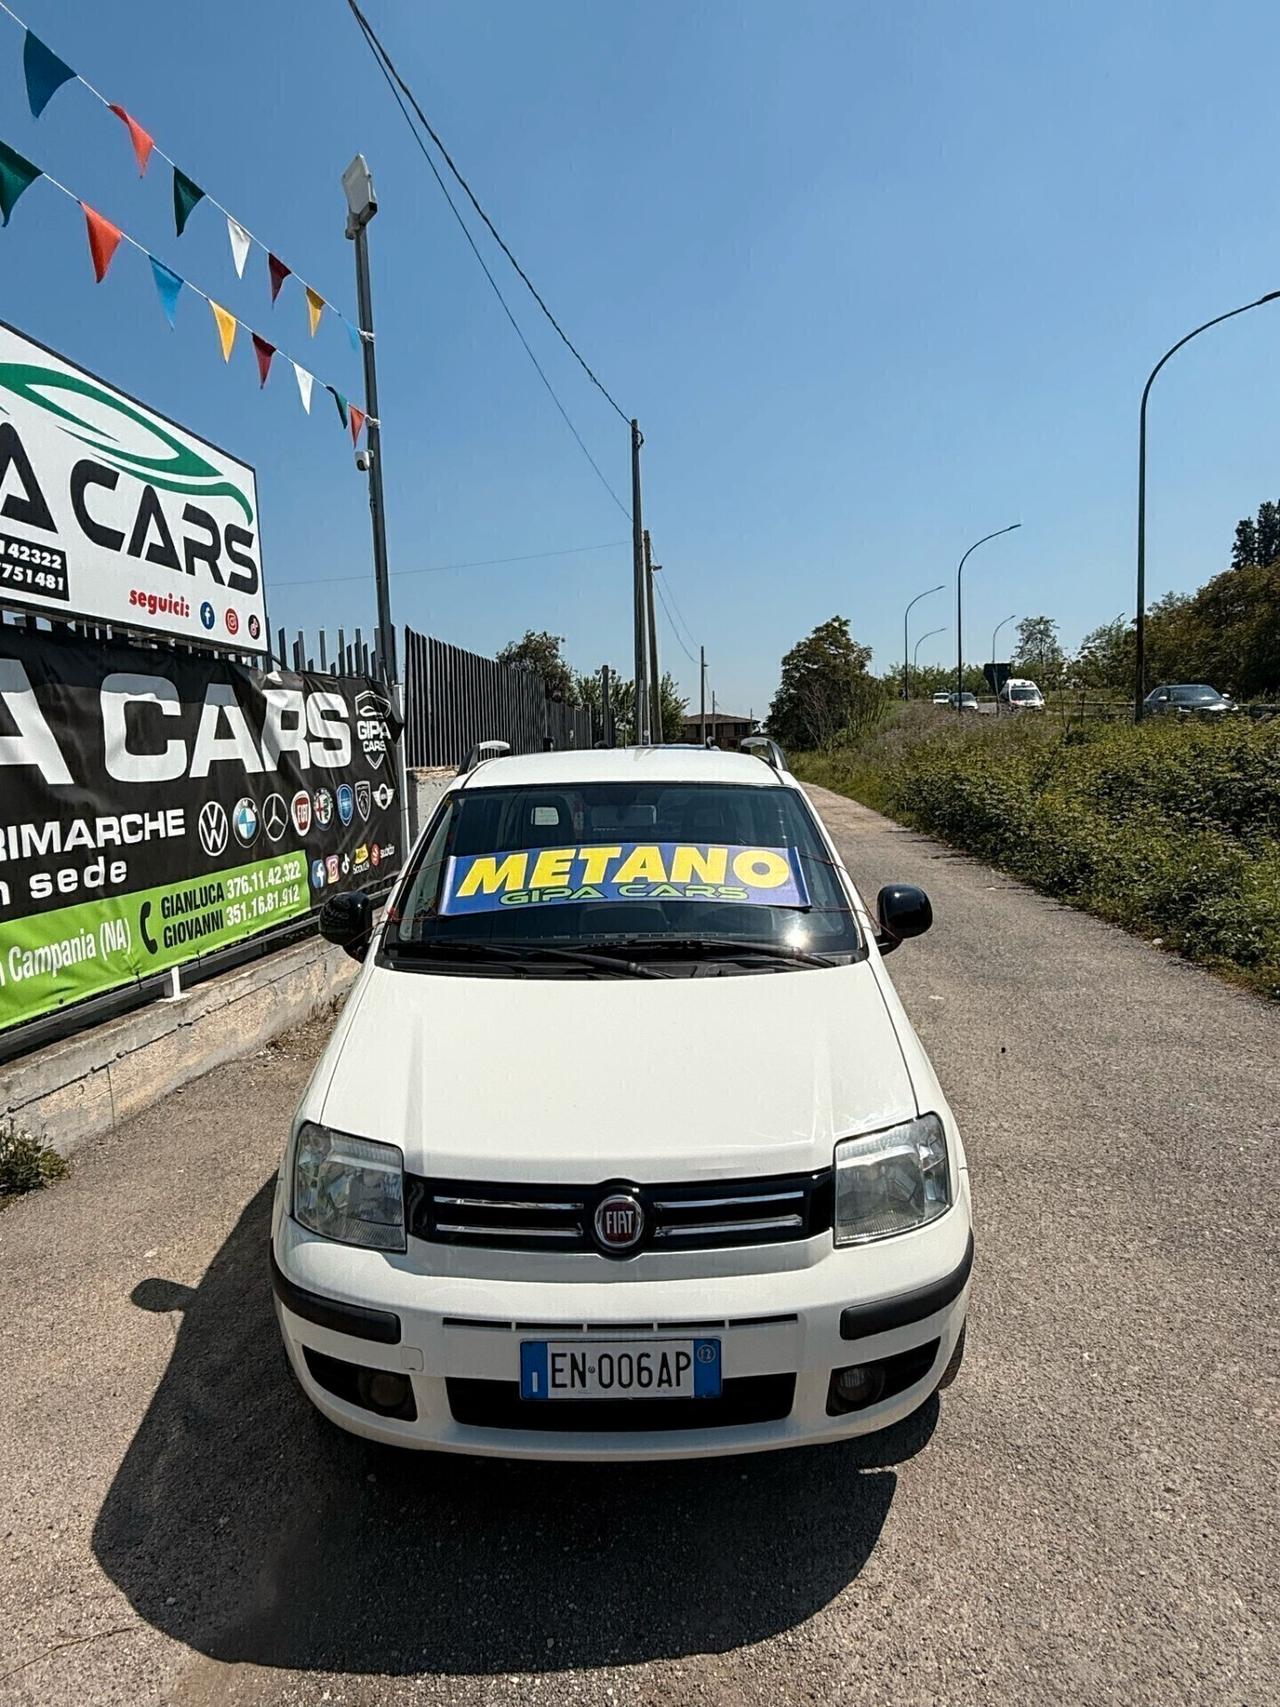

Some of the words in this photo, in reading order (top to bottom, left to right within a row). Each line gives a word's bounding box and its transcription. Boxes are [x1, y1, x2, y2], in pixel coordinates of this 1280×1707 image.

[70, 459, 259, 595] CARS
[0, 562, 64, 591] 751481
[129, 588, 190, 617] seguici:
[100, 672, 352, 783] CARS
[356, 720, 392, 741] GIPA
[362, 740, 386, 753] CARS
[0, 808, 186, 862] IMARCHE
[29, 855, 128, 900] sede
[160, 881, 225, 919] GIANLUCA
[226, 860, 302, 899] 376.11.42.322
[455, 846, 791, 898] METANO
[498, 883, 608, 906] GIPA
[616, 883, 750, 901] CARS
[163, 909, 224, 949] GIOVANNI
[225, 884, 301, 927] 351.16.81.912
[8, 927, 96, 982] Campania
[99, 917, 131, 961] (NA)
[605, 1209, 634, 1235] FIAT
